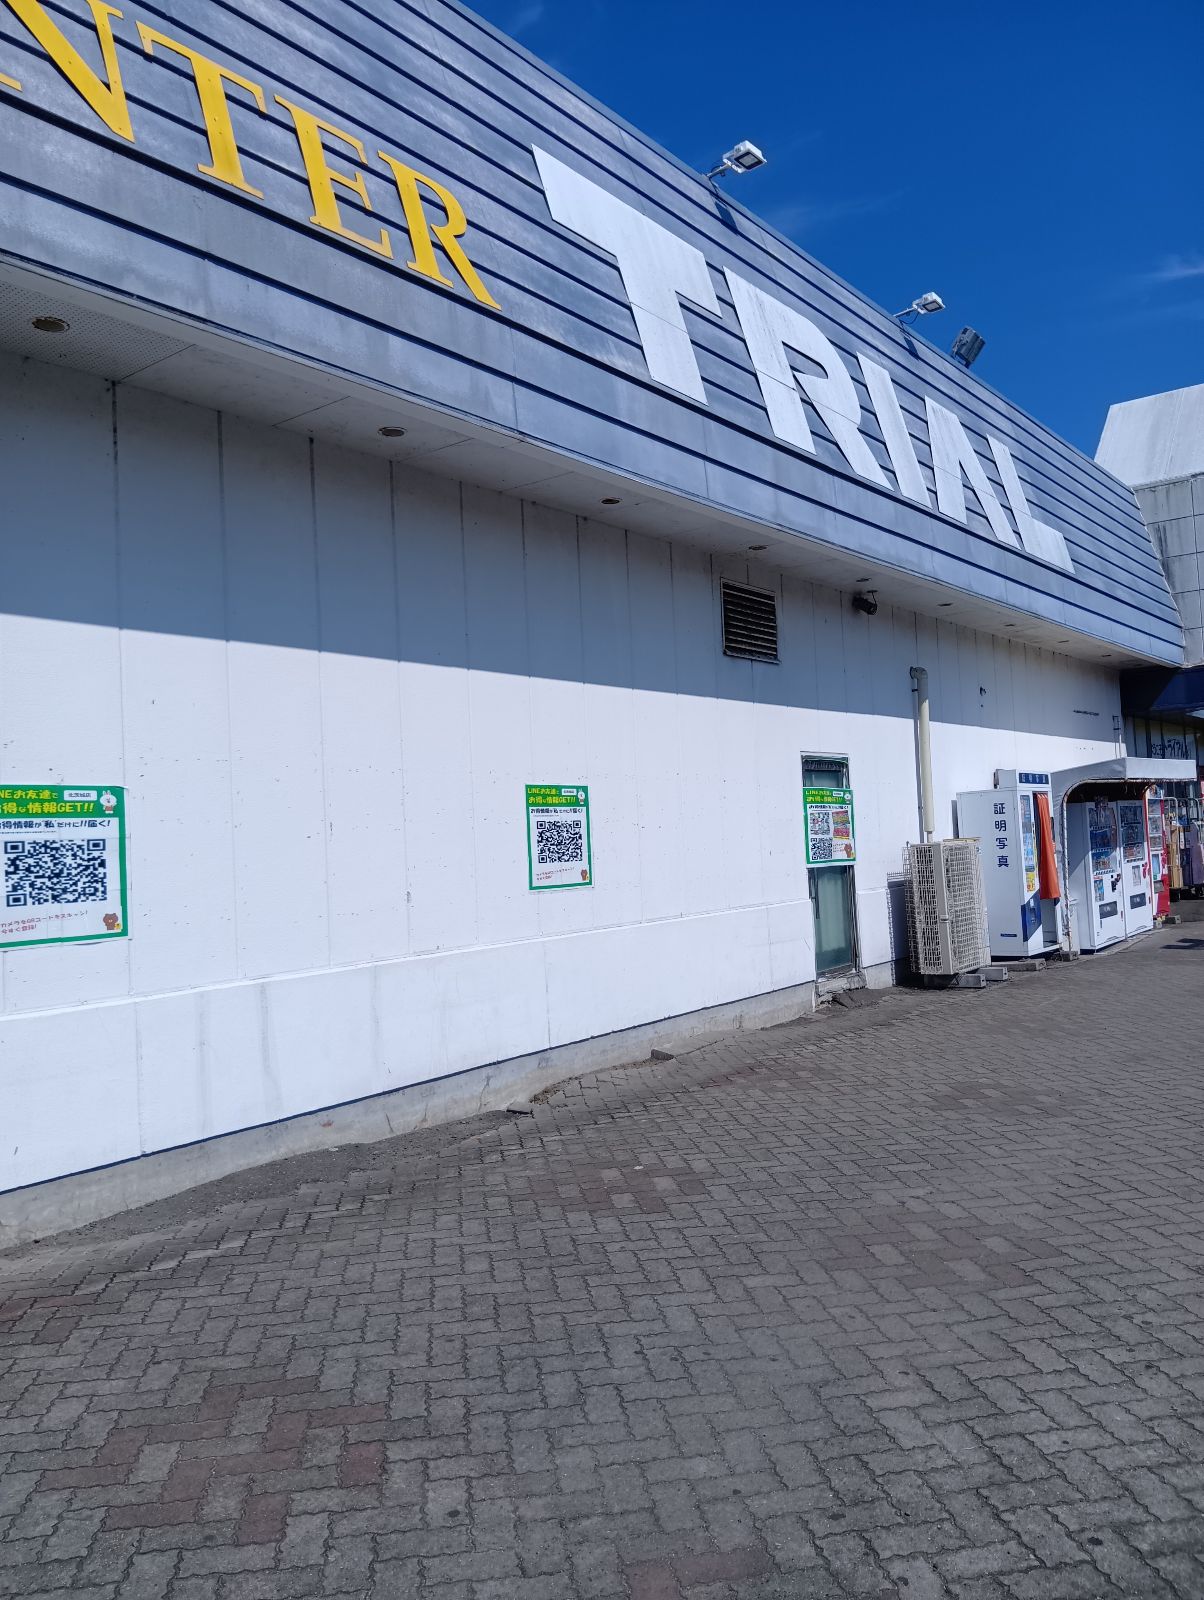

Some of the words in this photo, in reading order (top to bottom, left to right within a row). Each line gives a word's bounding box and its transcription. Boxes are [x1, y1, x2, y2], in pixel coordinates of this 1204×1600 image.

[531, 144, 1076, 575] TRIAL
[0, 802, 94, 814] 得な情報GET!!
[994, 802, 1010, 868] 証明写真
